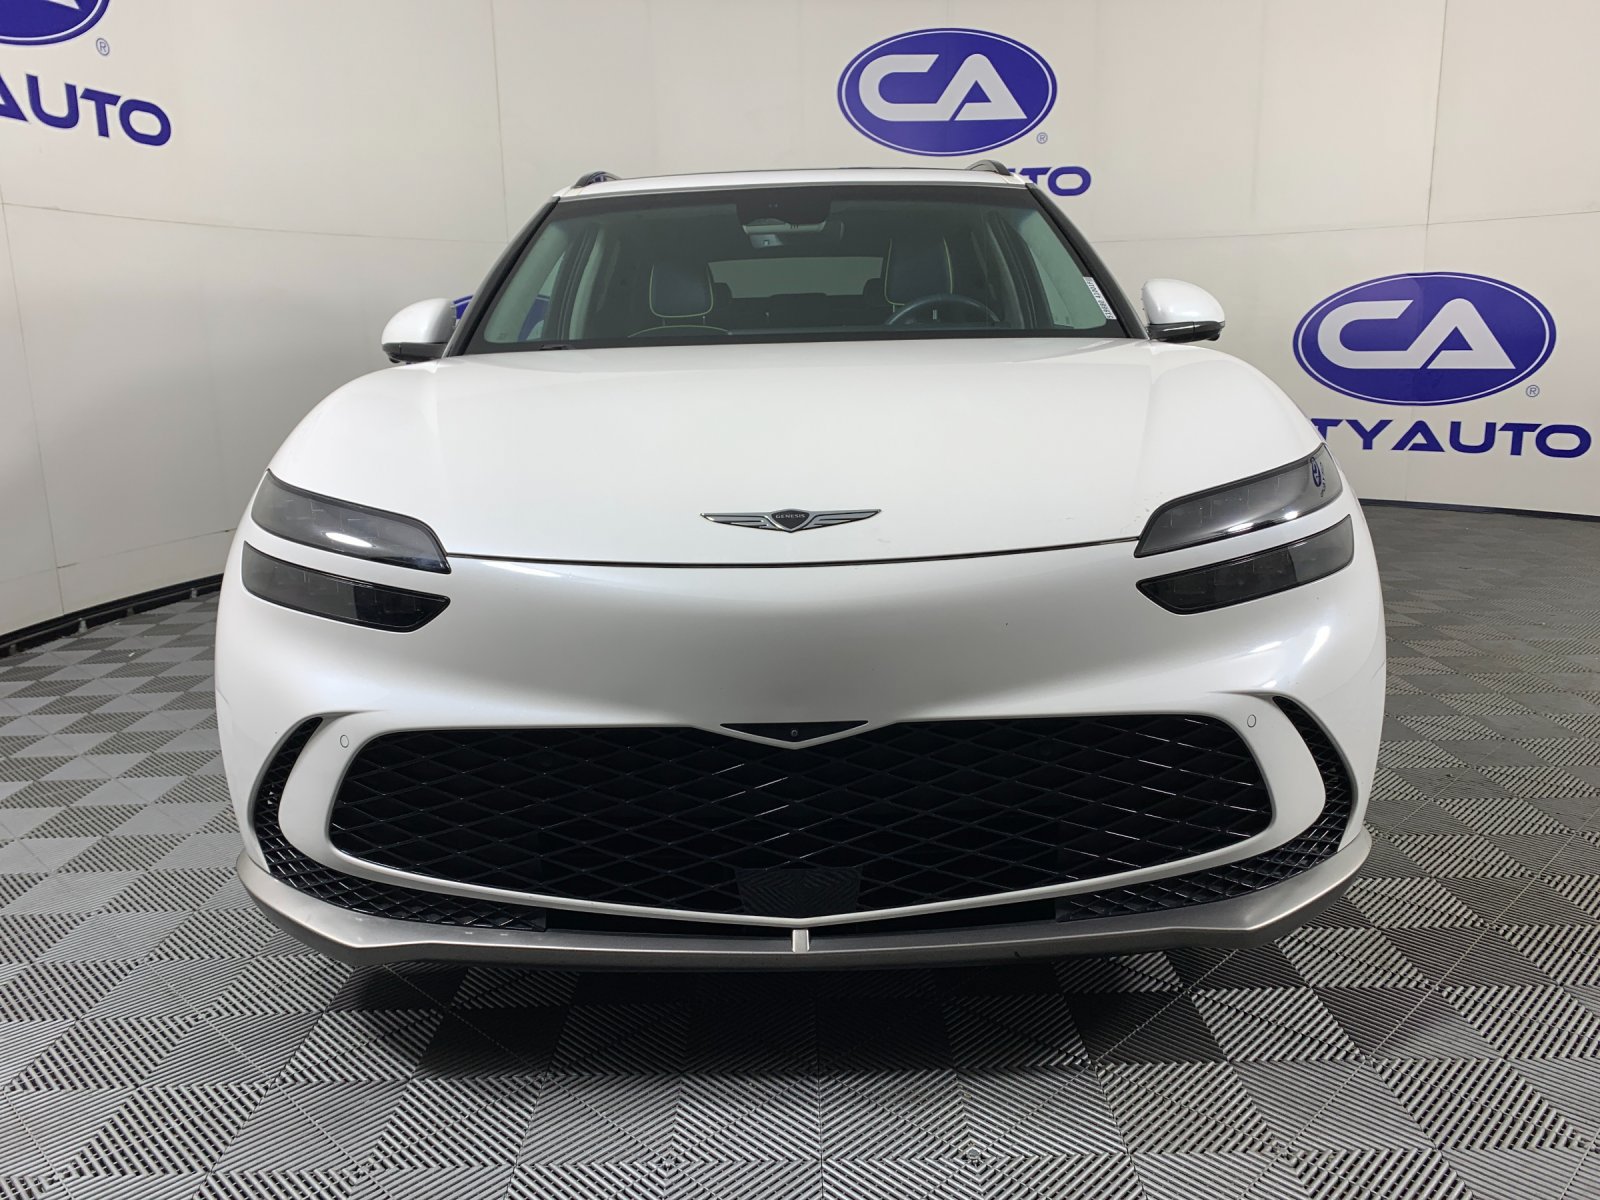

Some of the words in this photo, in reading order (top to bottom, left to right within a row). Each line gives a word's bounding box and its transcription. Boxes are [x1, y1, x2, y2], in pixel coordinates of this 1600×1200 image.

[858, 53, 1028, 122] CA
[1007, 166, 1091, 196] TO
[1317, 298, 1516, 369] CA
